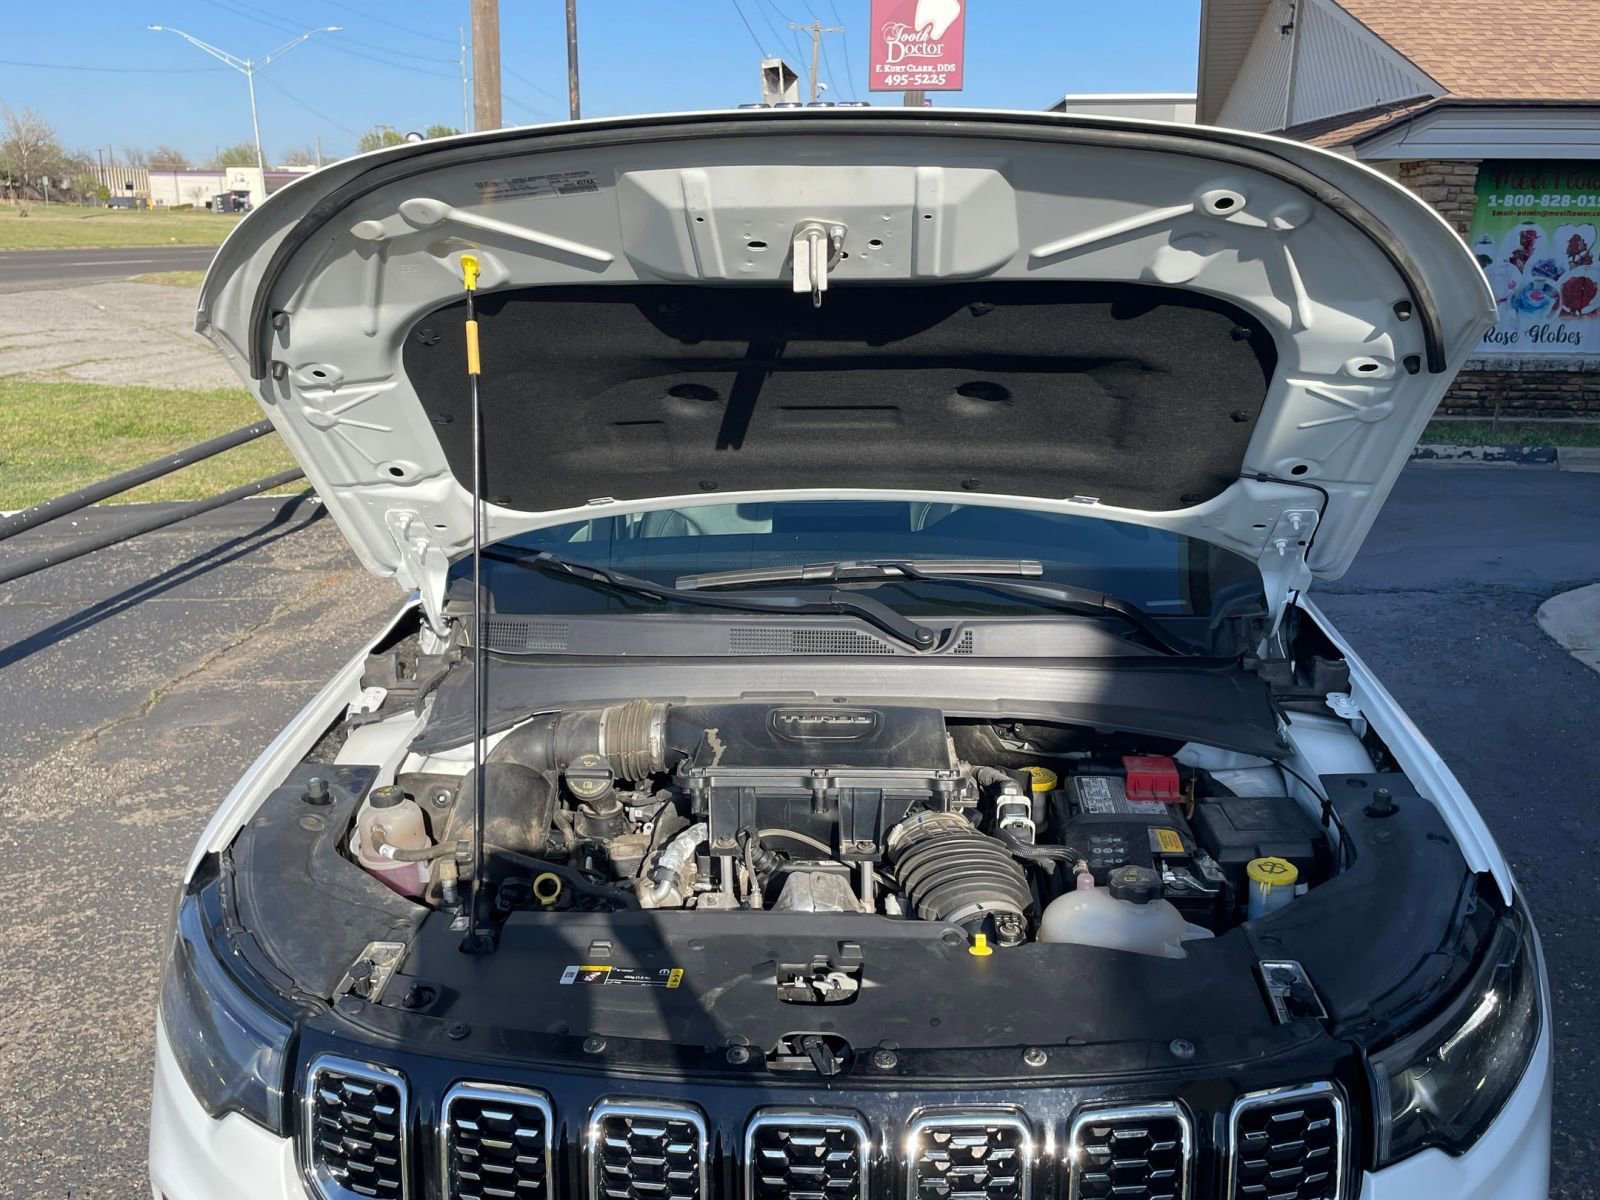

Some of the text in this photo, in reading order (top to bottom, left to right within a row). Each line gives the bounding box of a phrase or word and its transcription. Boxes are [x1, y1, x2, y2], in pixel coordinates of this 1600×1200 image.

[882, 21, 931, 42] Tooth
[886, 41, 944, 64] Doctor
[937, 63, 956, 72] DDS
[884, 73, 947, 86] 495-5225
[1483, 324, 1582, 346] Rose Globes
